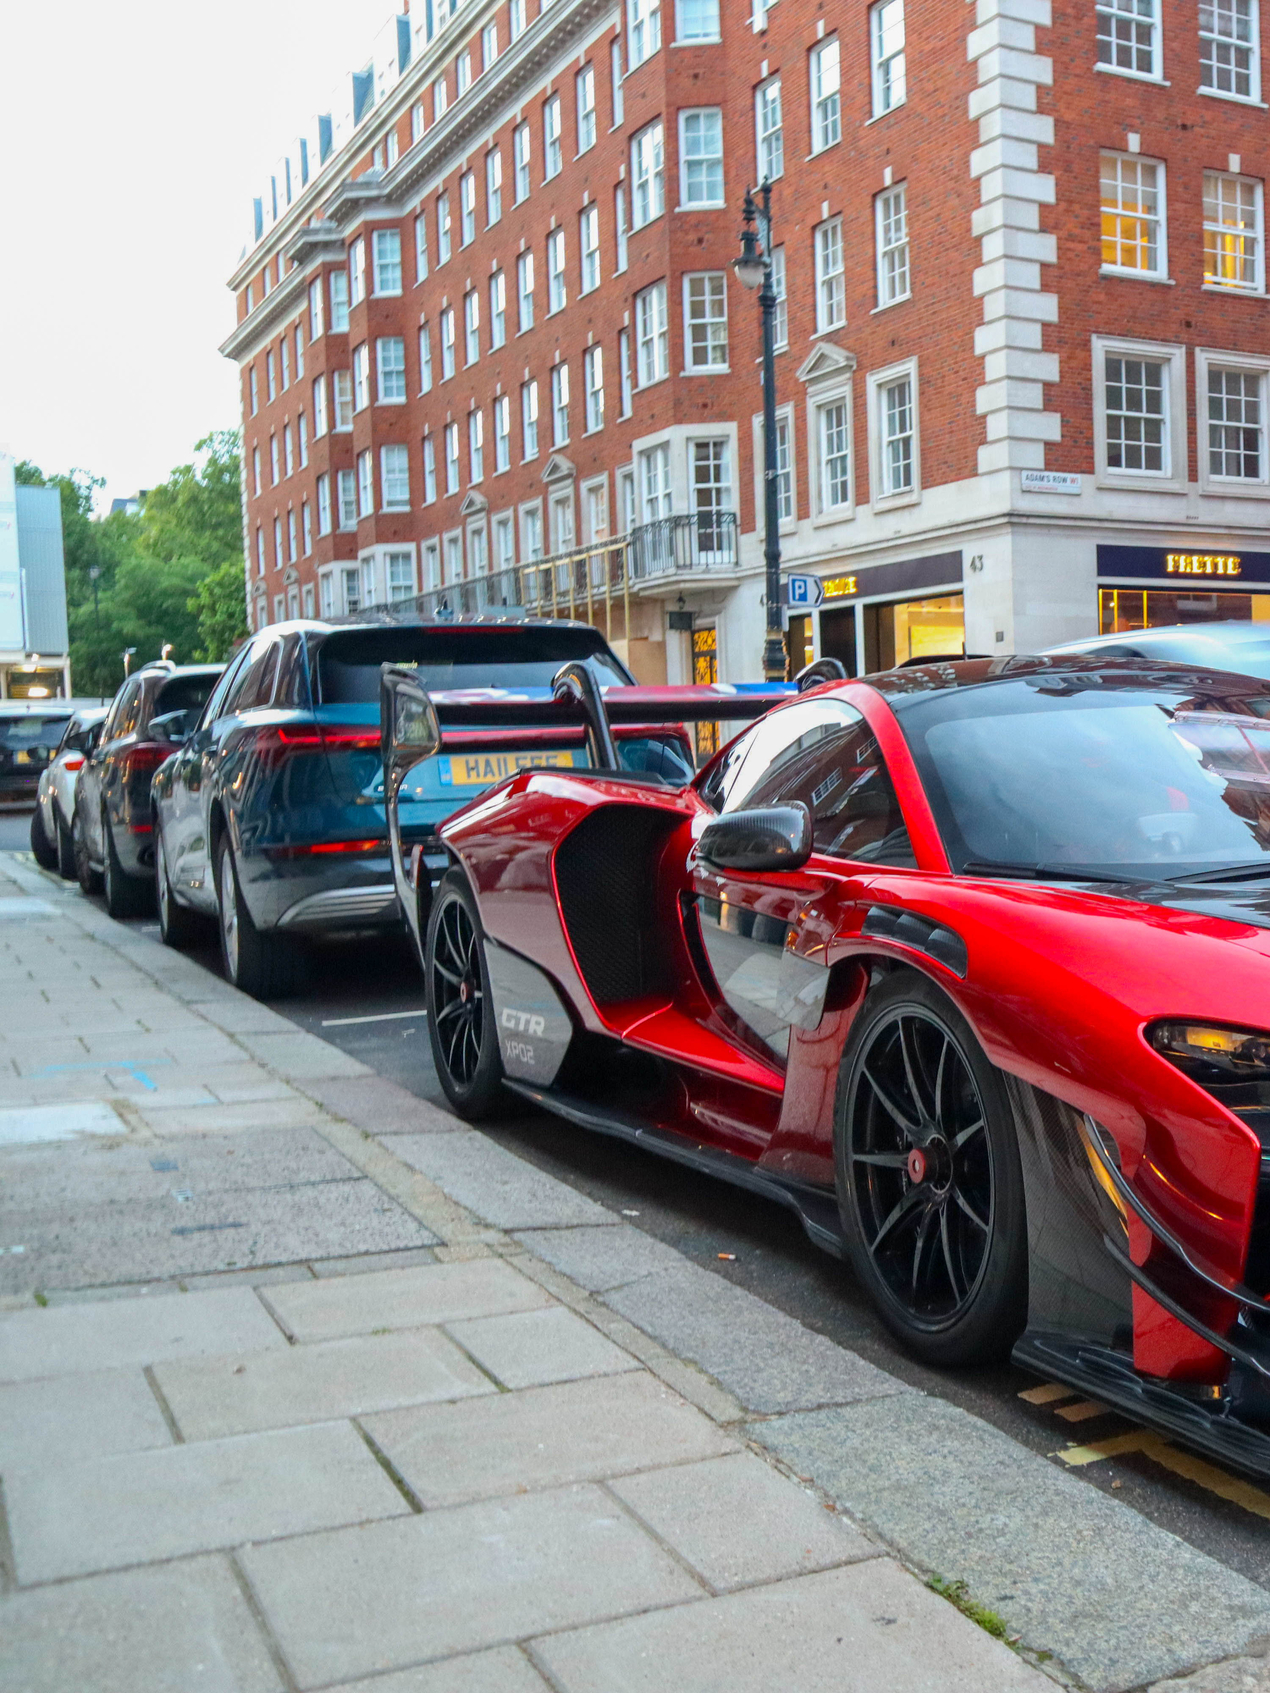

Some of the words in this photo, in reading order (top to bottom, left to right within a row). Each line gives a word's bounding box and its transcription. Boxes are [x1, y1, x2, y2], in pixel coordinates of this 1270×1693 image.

[1052, 475, 1069, 484] ROW
[970, 555, 984, 572] 43
[794, 580, 806, 601] P
[502, 1008, 546, 1037] GTR
